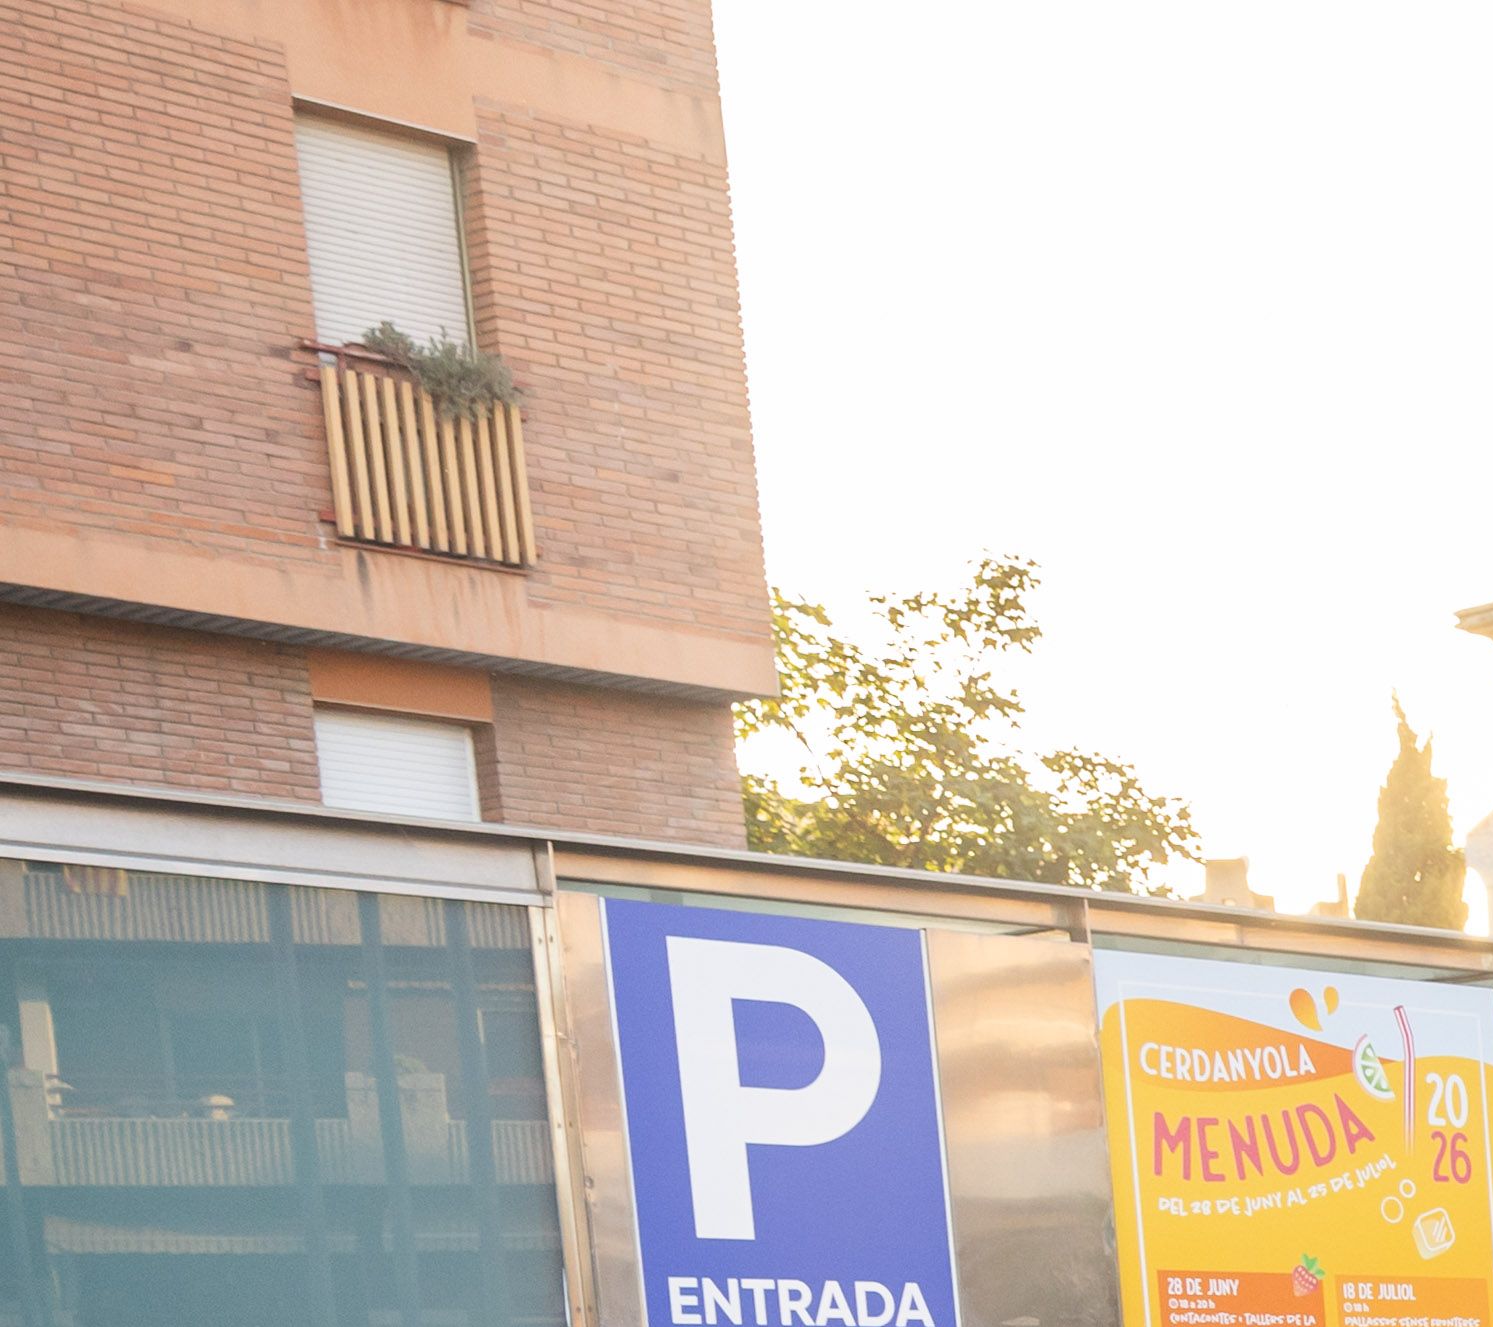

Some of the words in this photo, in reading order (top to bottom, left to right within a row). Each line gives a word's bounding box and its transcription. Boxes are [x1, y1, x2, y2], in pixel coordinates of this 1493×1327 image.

[666, 936, 881, 1240] P
[1139, 1042, 1316, 1083] CERDANYOLA
[1425, 1072, 1468, 1129] 20
[1153, 1093, 1376, 1183] MENUDA
[1430, 1131, 1472, 1184] 26
[1158, 1197, 1188, 1216] DEL
[1190, 1200, 1212, 1215] 28
[1216, 1197, 1241, 1215] DE
[1244, 1191, 1283, 1216] JUNY
[1286, 1188, 1308, 1207] AL
[1329, 1172, 1353, 1195] DE
[667, 1276, 935, 1327] ENTRADA
[1167, 1277, 1183, 1296] 28
[1185, 1277, 1203, 1296] DE
[1207, 1278, 1240, 1296] JUNY
[1343, 1282, 1355, 1299] 18
[1358, 1283, 1374, 1300] DE
[1378, 1283, 1416, 1300] JULIOL
